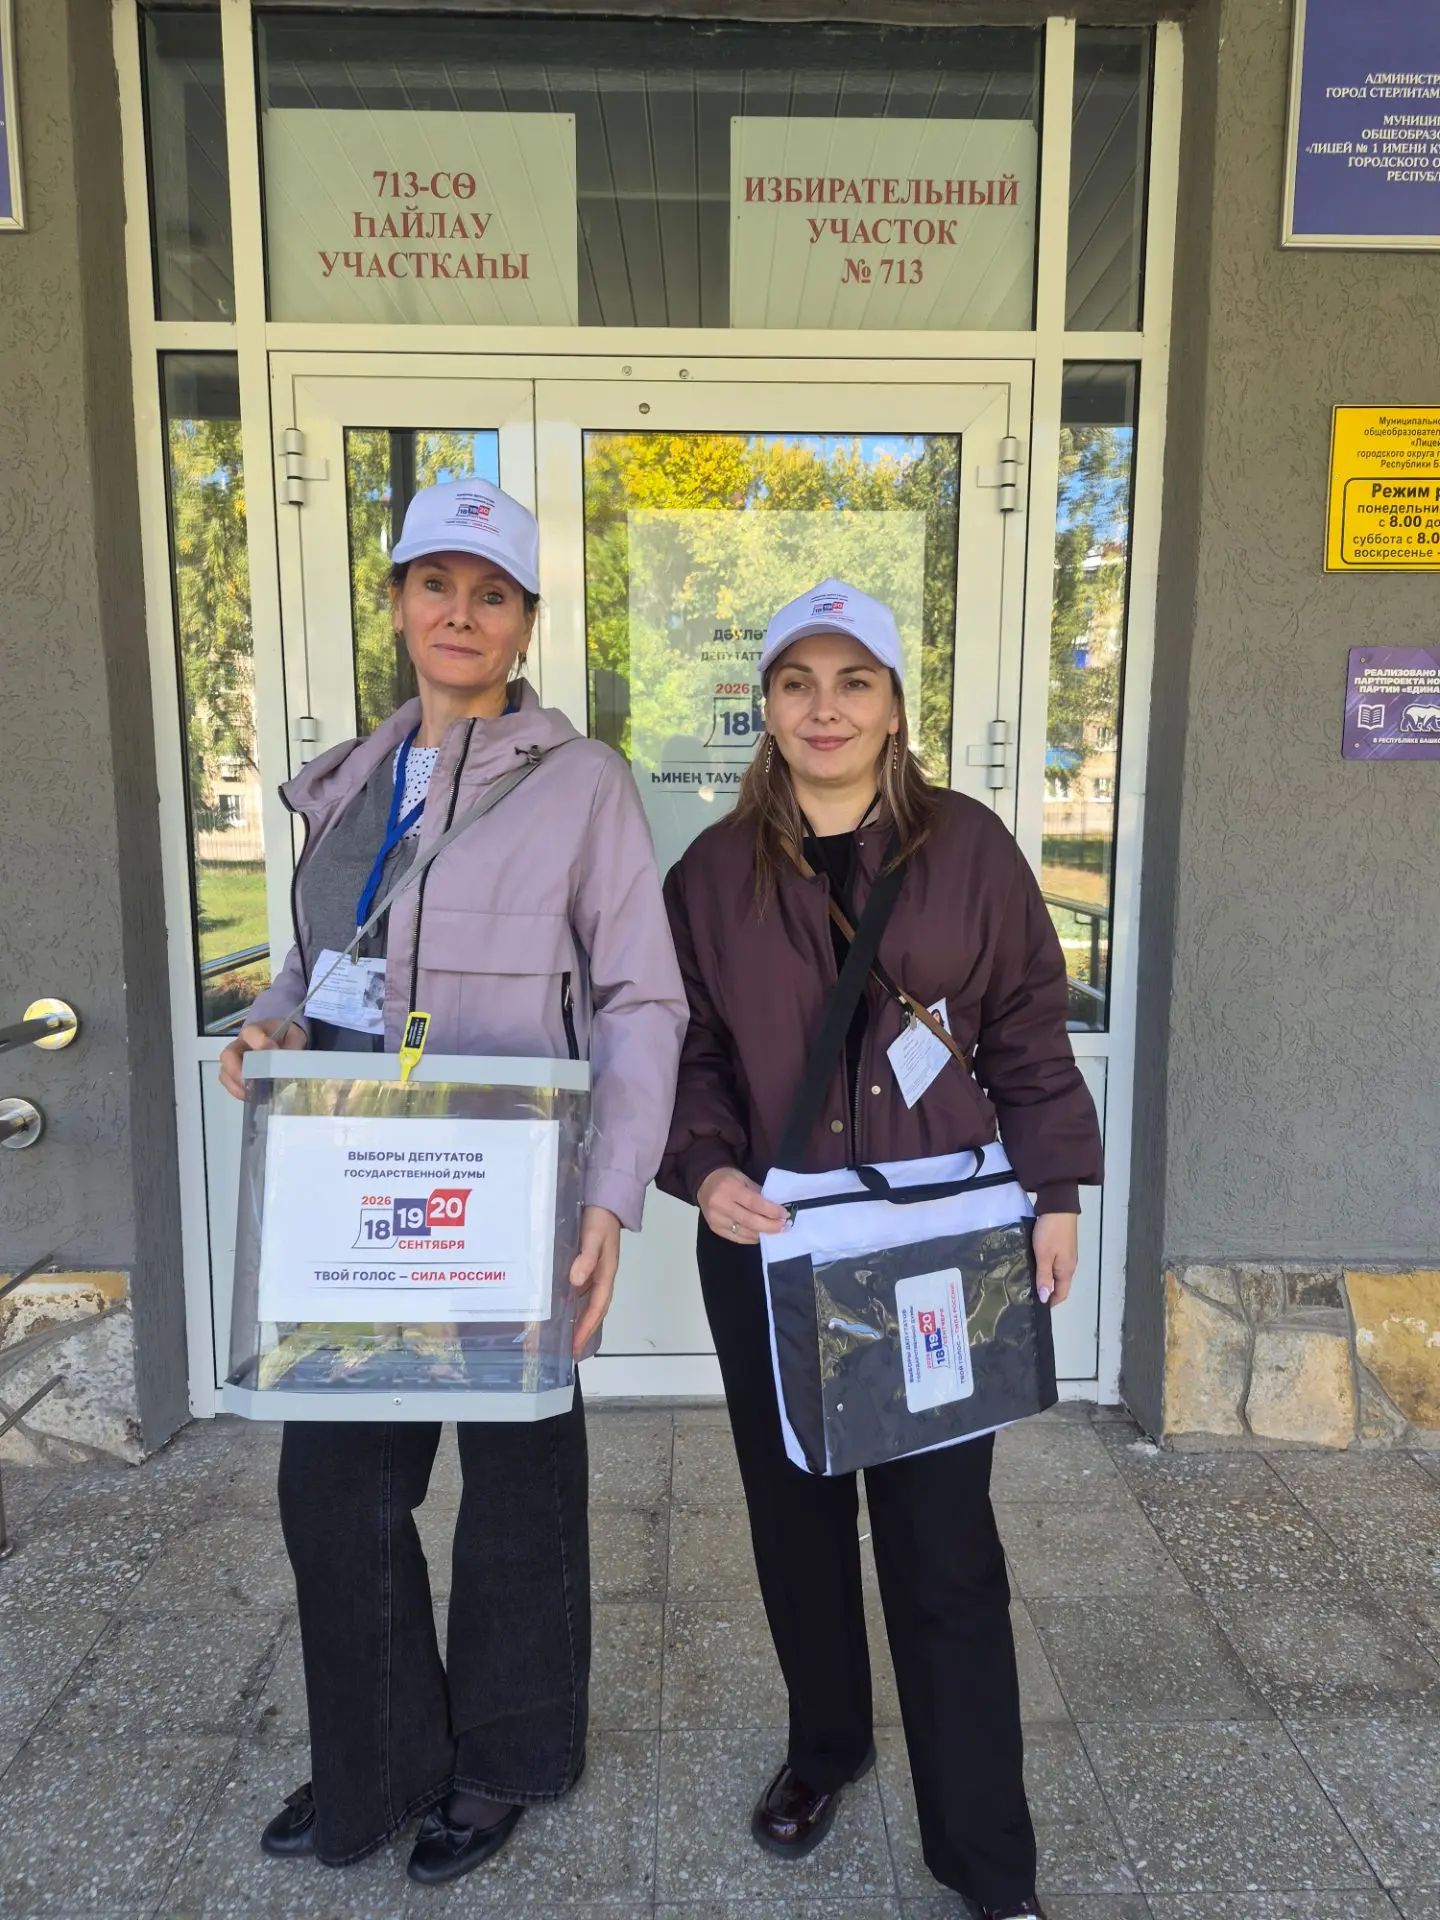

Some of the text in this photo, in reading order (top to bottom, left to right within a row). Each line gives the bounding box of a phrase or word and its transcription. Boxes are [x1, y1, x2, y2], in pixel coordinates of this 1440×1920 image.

[1365, 73, 1440, 85] АДМИНИСТР
[1326, 87, 1440, 99] ГОРОД СТЕРЛИТАМ
[1356, 143, 1368, 153] №
[1373, 143, 1378, 153] 1
[1382, 143, 1426, 154] ИМЕНИ
[1348, 157, 1429, 169] ГОРОДСКОГО
[744, 172, 1019, 207] ИЗБИРАТЕЛЬНЫЙ
[806, 217, 957, 246] УЧАСТОК
[317, 250, 530, 280] УЧАСТКАҺЫ
[841, 258, 924, 286] № 713
[1357, 450, 1405, 459] городского
[1406, 450, 1435, 460] округа
[1380, 460, 1431, 470] Республики
[1372, 483, 1429, 498] Режим
[1379, 519, 1385, 527] с
[1389, 515, 1422, 528] 8.00
[1353, 533, 1403, 546] суббота
[1406, 535, 1413, 544] с
[1354, 549, 1433, 559] воскресенье
[1364, 669, 1436, 677] РЕАЛИЗОВАНО
[1354, 677, 1425, 685] ПАРТПРОЕКТА
[715, 683, 750, 694] 2026
[1359, 685, 1440, 694] ПАРТИИ «ЕДИНА
[719, 711, 750, 736] 18
[348, 1151, 483, 1163] ВЫБОРЫ ДЕПУТАТОВ
[344, 1168, 485, 1180] ГОСУДАРСТВЕННОЙ ДУМЫ
[361, 1195, 391, 1206] 2026
[364, 1197, 463, 1240] 18 19 20
[398, 1240, 465, 1250] СЕНТЯБРЯ
[314, 1269, 350, 1281] ТВОЙ
[352, 1271, 397, 1281] ГОЛОС
[411, 1270, 446, 1281] СИЛА
[449, 1270, 506, 1281] РОССИИ!
[923, 1313, 932, 1332] 20
